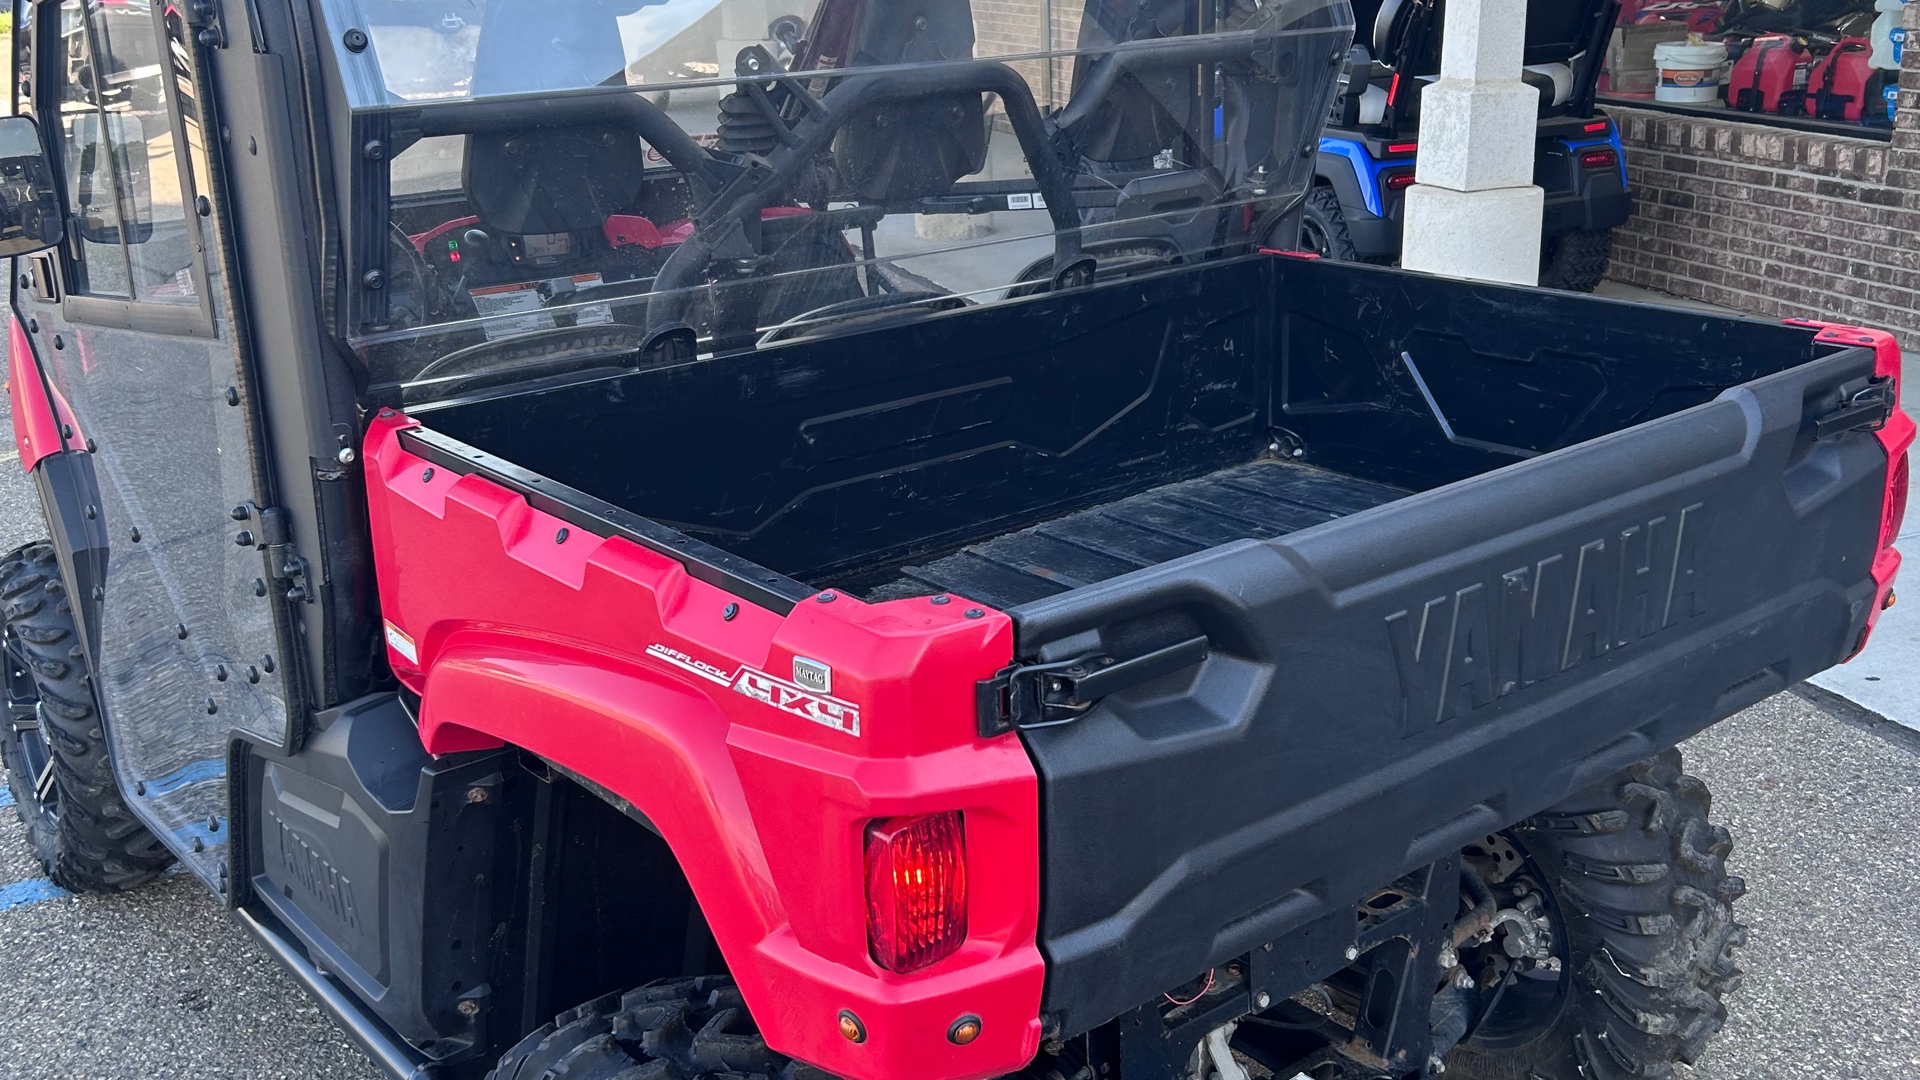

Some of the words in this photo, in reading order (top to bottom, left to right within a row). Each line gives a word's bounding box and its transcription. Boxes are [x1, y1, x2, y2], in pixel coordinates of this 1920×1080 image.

[648, 643, 728, 679] DIFFLOCK
[1384, 501, 1706, 740] YAMAHA
[795, 665, 824, 685] MAYTAG
[268, 809, 365, 937] YAMAHA
